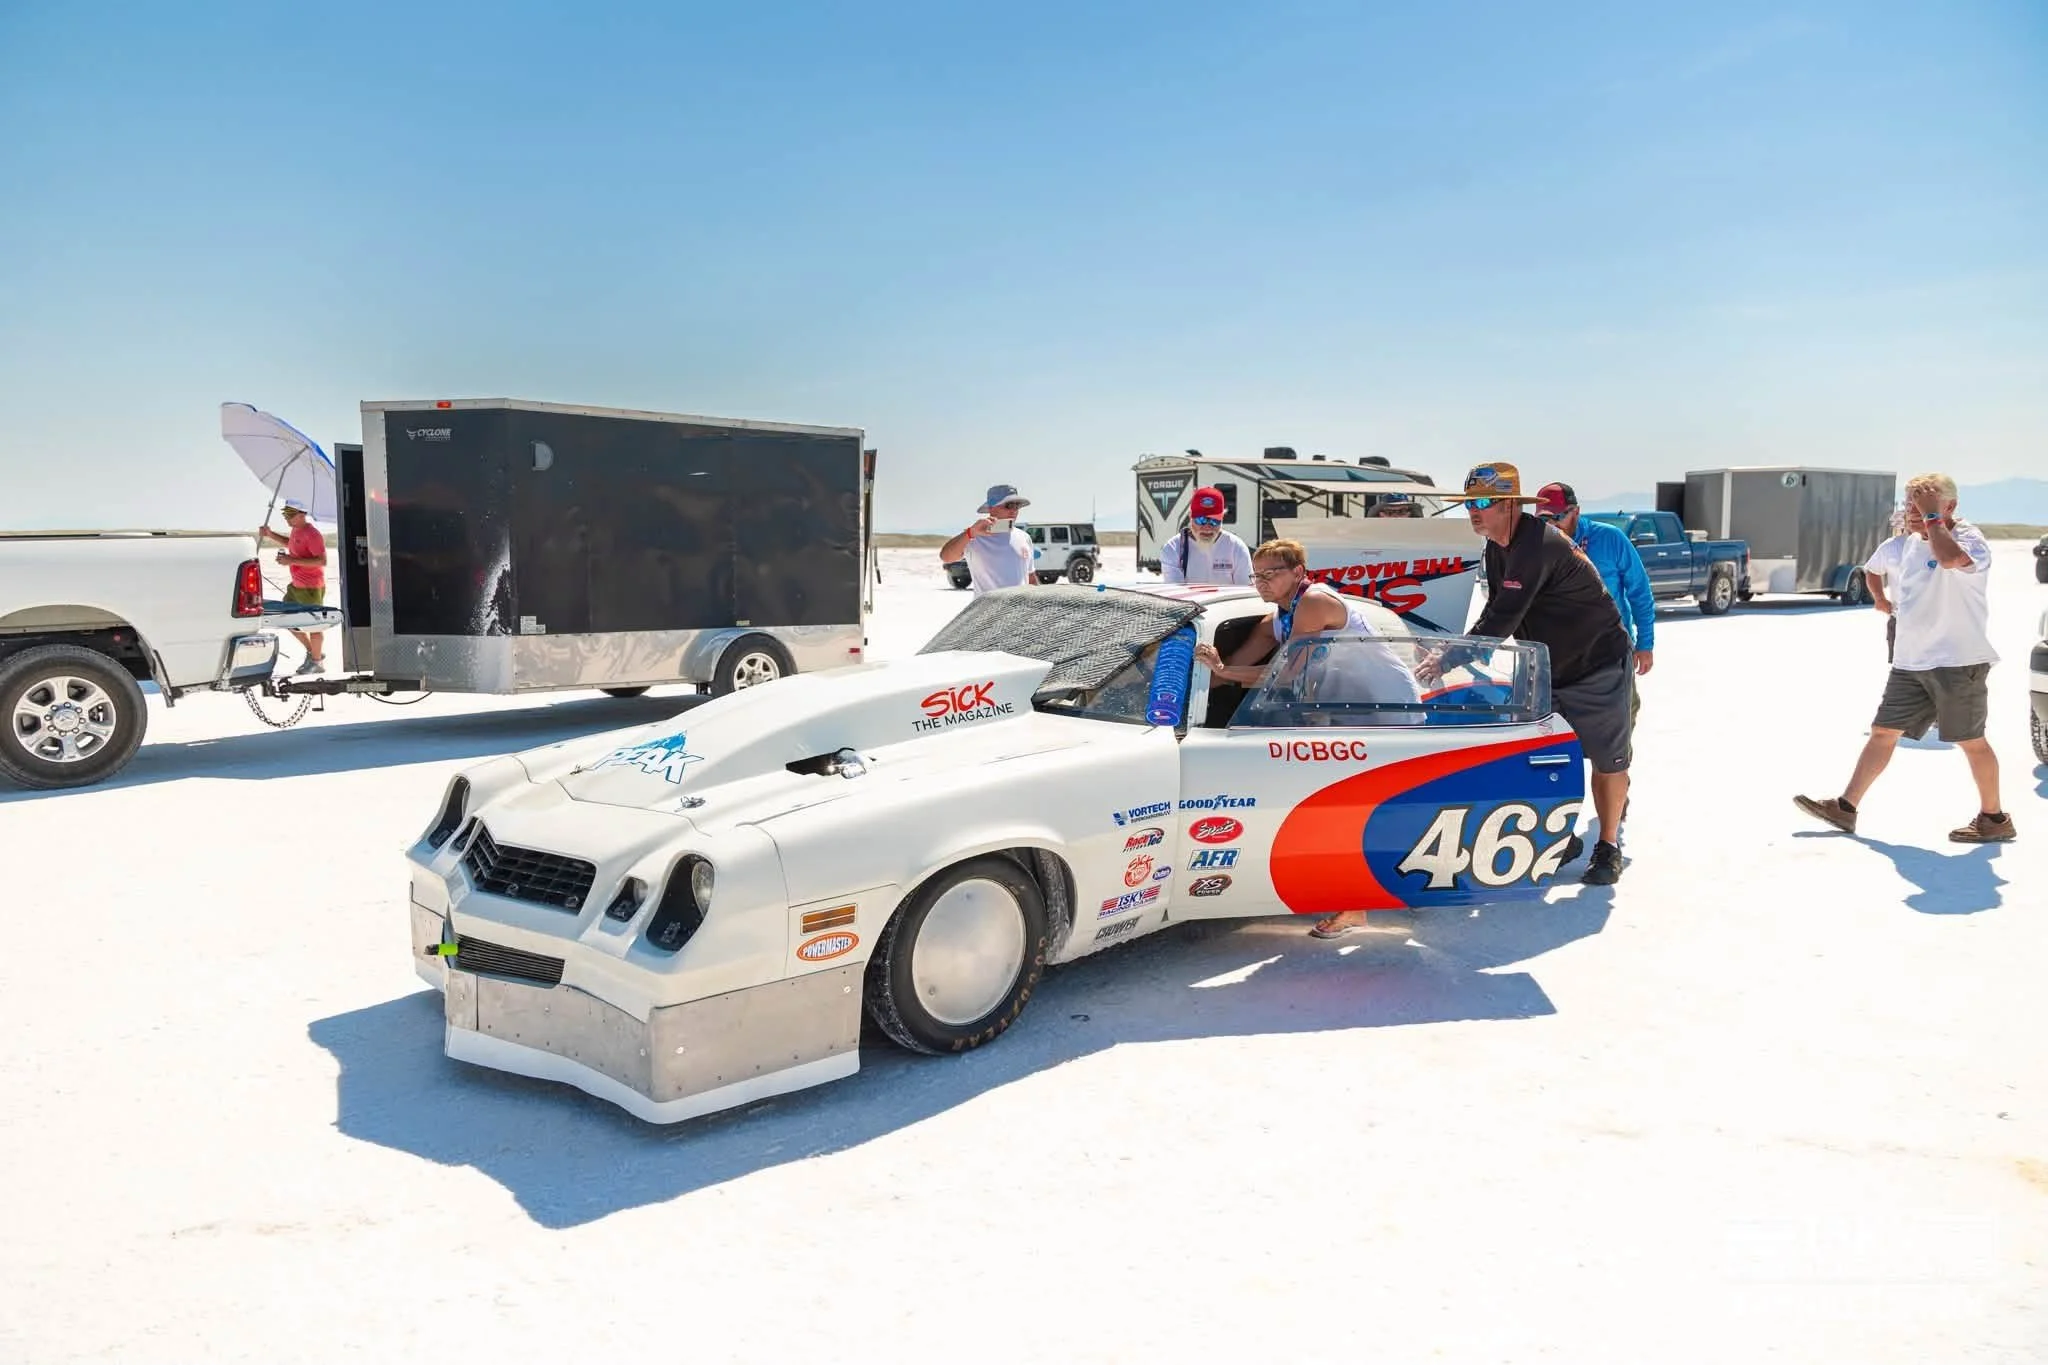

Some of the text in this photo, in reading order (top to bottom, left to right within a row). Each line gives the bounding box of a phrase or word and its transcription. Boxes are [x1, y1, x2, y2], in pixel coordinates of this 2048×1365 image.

[417, 428, 452, 437] CYCLONE
[1147, 480, 1185, 489] TORQUE
[1413, 556, 1464, 577] THE
[912, 702, 1015, 732] THE MAGAZINE
[588, 746, 705, 784] PEAK
[1128, 801, 1171, 818] VORTECH
[1191, 850, 1238, 867] AFR
[1195, 878, 1224, 891] XS
[1117, 889, 1147, 907] ISKY
